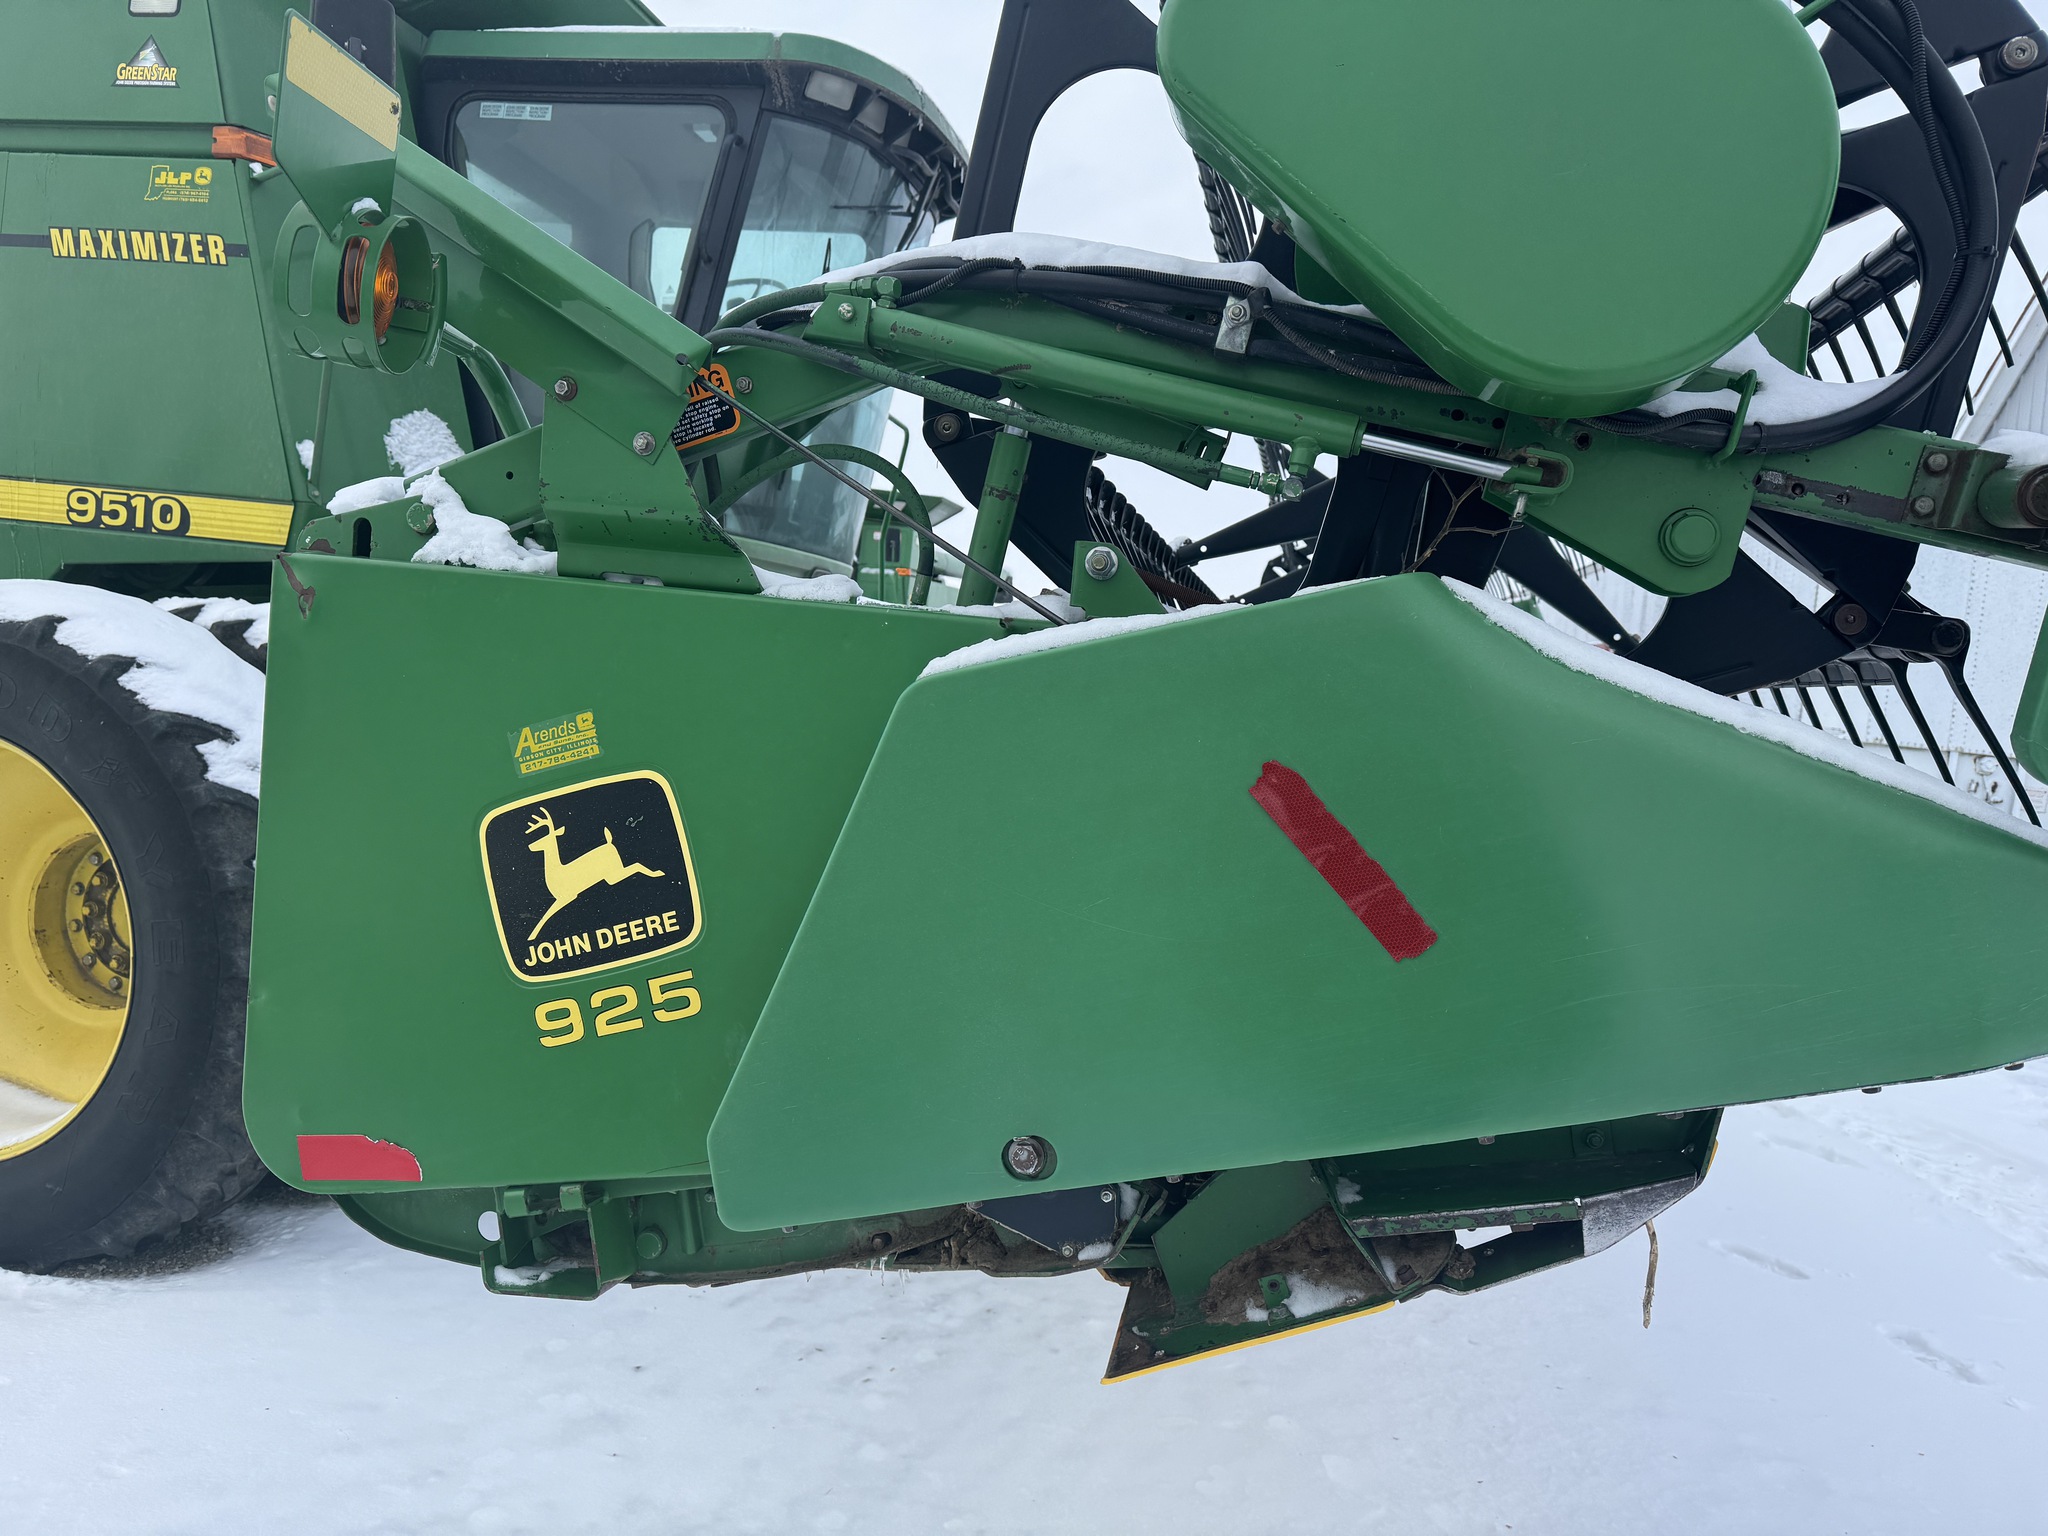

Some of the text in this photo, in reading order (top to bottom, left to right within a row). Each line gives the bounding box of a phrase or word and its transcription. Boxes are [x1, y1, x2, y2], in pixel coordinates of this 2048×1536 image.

[49, 227, 228, 265] MAXIMIZER
[702, 397, 719, 406] raised
[685, 410, 698, 418] stop
[691, 413, 708, 421] safety
[709, 408, 721, 416] stop
[691, 416, 714, 427] working
[673, 431, 686, 439] stop
[692, 421, 714, 431] located
[682, 430, 704, 441] cylinder
[67, 489, 184, 533] 9510
[514, 720, 576, 758] Arends
[518, 752, 544, 762] GIBSON
[566, 738, 599, 749] ILLINOIS
[524, 747, 596, 772] 217-784-4241
[524, 910, 680, 967] JOHN DEERE
[533, 969, 702, 1049] 925
